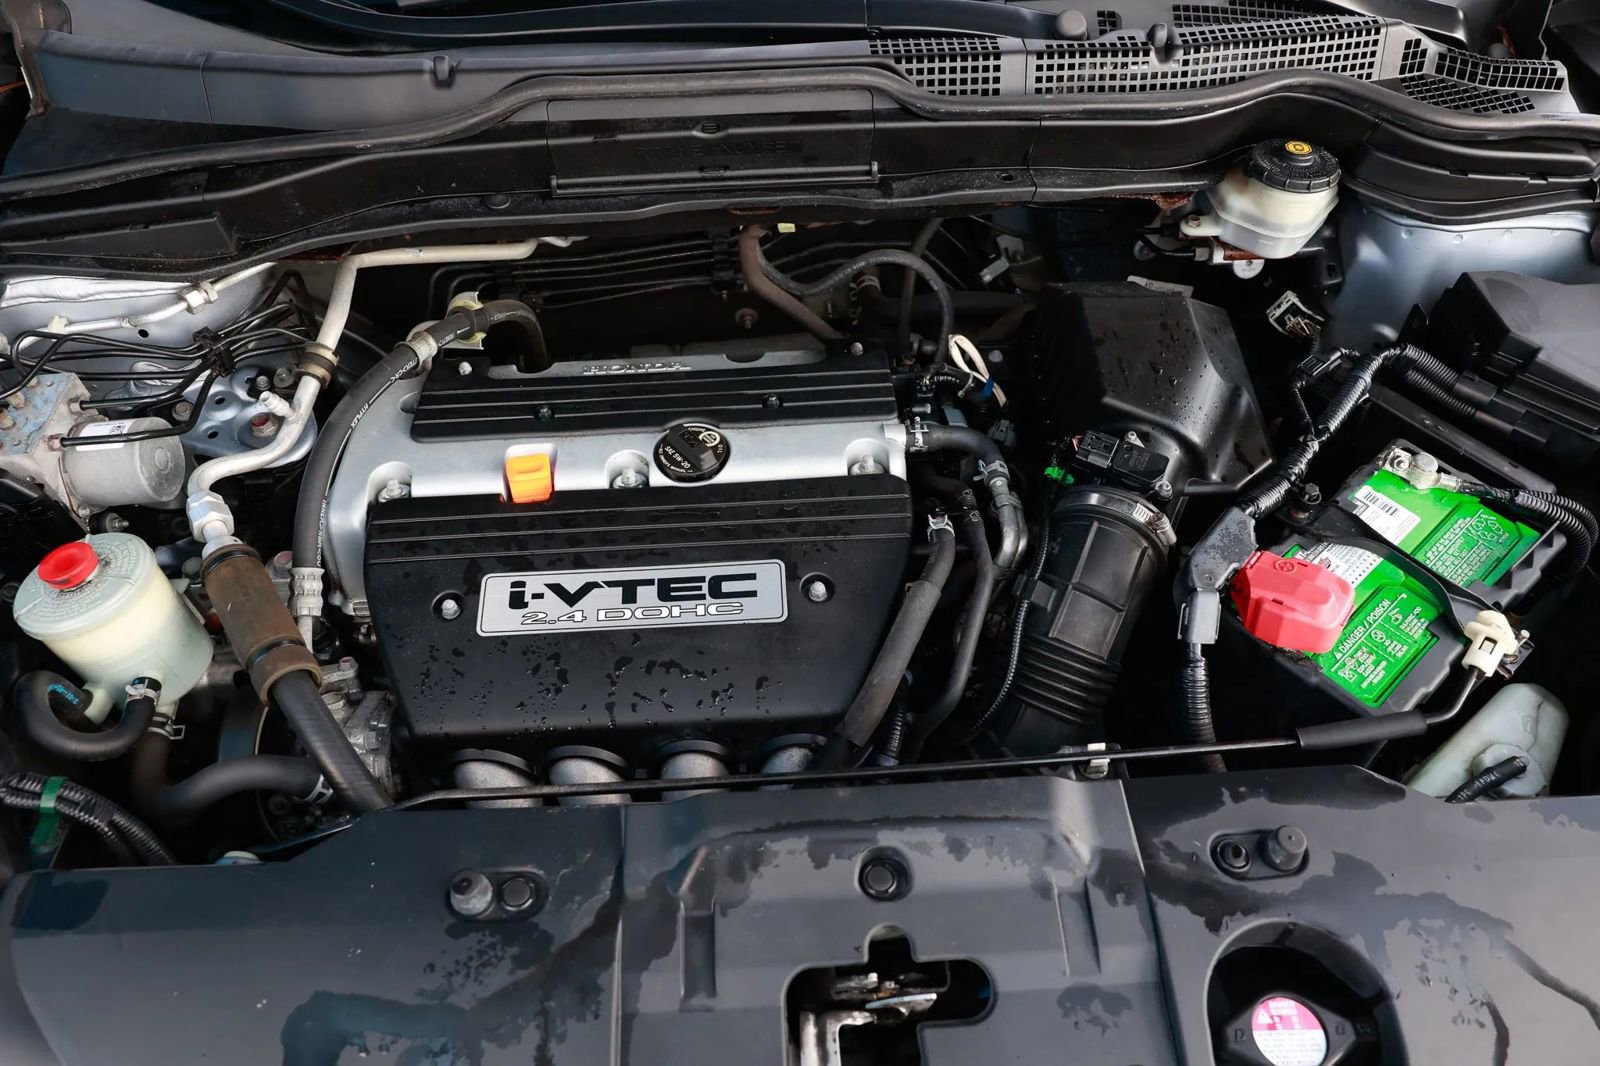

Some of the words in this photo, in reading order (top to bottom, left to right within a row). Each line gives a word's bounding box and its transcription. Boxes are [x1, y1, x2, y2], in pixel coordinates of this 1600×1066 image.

[672, 453, 691, 469] 5W-20
[508, 572, 757, 610] i-VTEC
[520, 608, 587, 625] 2.4
[596, 602, 743, 622] DOHC
[1339, 625, 1367, 653] DANGER
[1366, 598, 1391, 624] POISON
